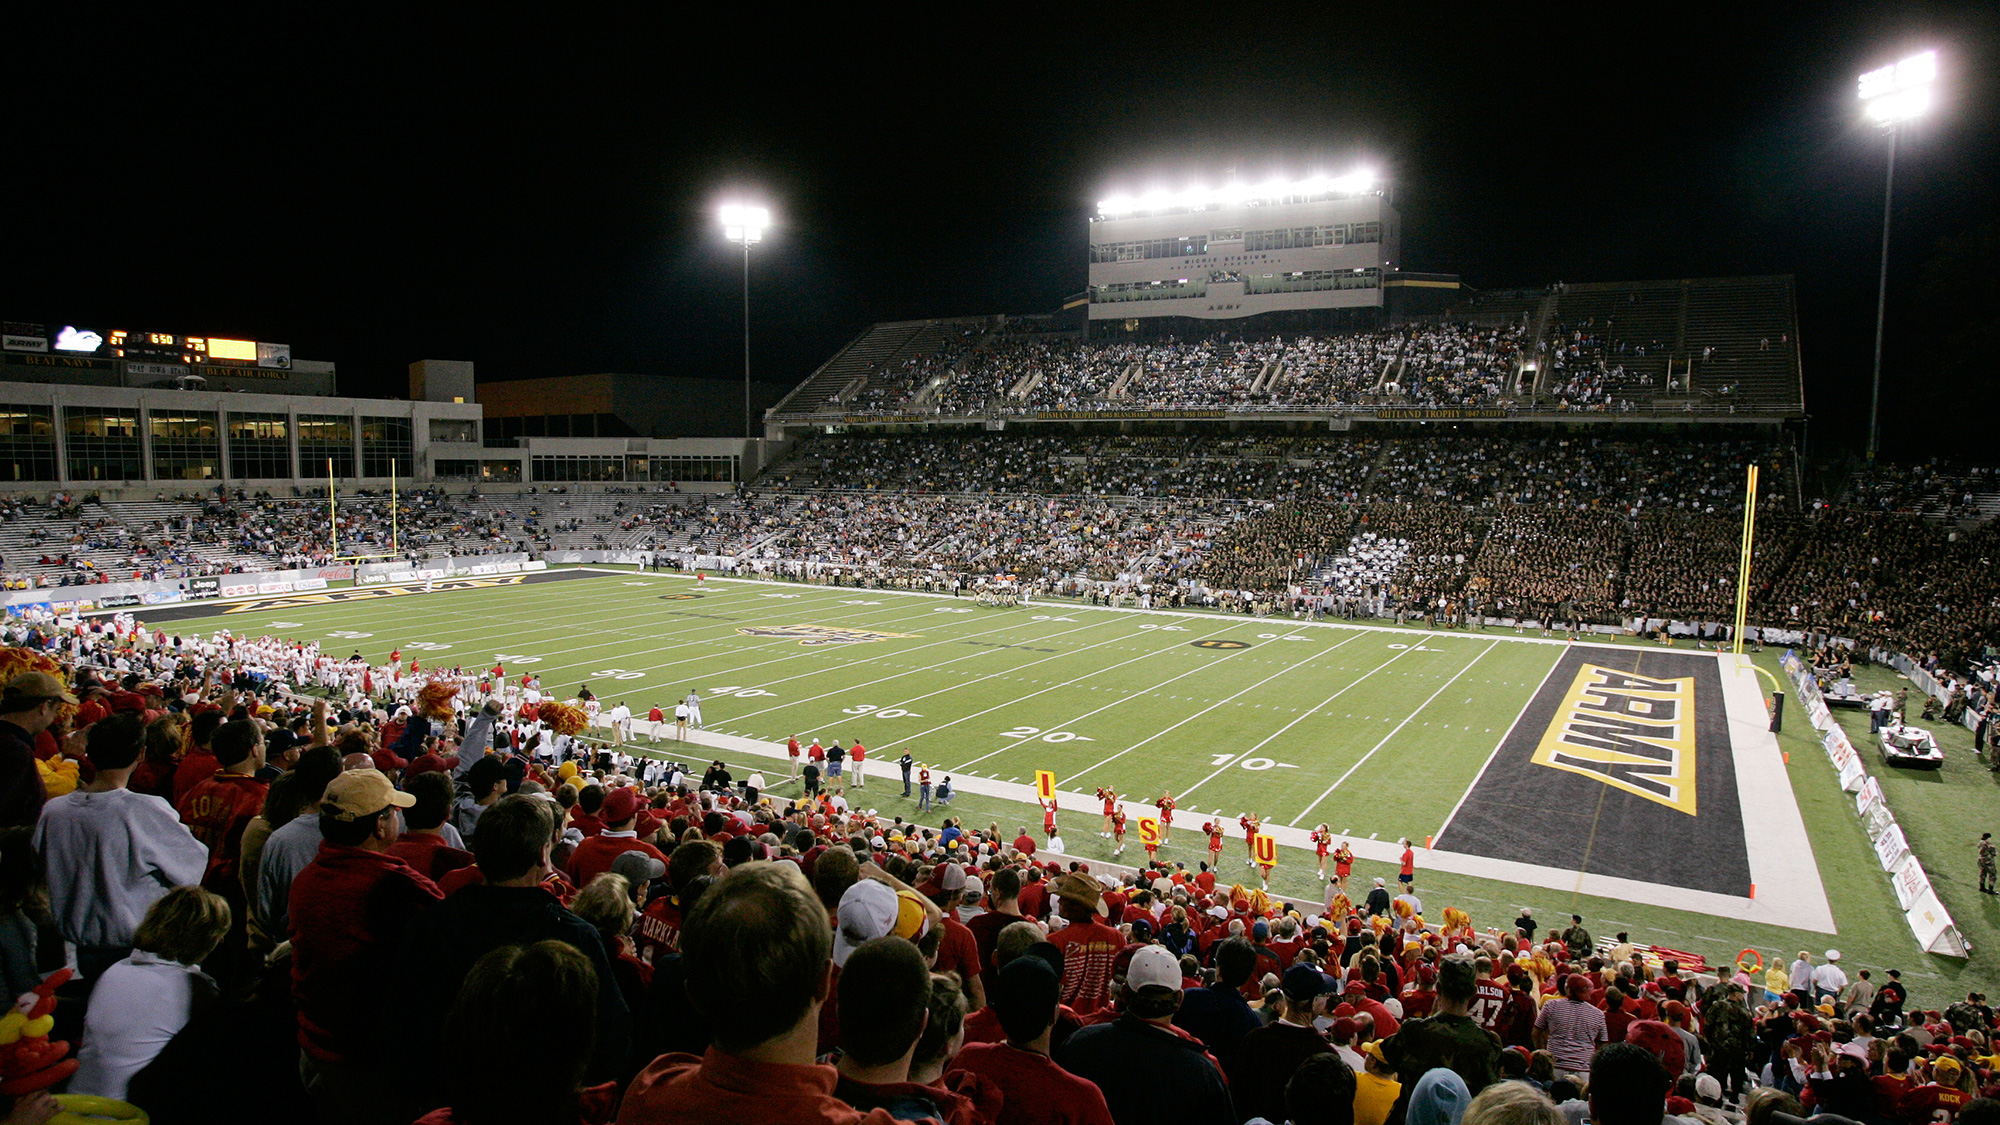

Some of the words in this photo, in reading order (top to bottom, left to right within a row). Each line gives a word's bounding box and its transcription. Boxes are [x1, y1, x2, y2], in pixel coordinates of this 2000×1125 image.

[7, 339, 43, 348] ARMY
[26, 355, 56, 366] BEAT
[63, 358, 94, 368] NAVY
[206, 367, 232, 376] BEAT
[236, 369, 254, 377] AIR
[258, 371, 288, 380] FORCE
[1071, 411, 1098, 419] TROPHY
[1378, 409, 1421, 419] OUTLAND
[1425, 409, 1460, 418] TROPHY
[193, 580, 217, 589] Jeep
[363, 574, 387, 583] Jeep
[591, 668, 646, 680] 50
[708, 686, 766, 697] 40
[842, 704, 908, 719] 30
[999, 726, 1077, 743] 20
[1546, 667, 1683, 804] ARMY
[1211, 753, 1276, 771] 10
[1041, 773, 1050, 797] I
[1140, 819, 1157, 842] S
[1256, 836, 1275, 862] U
[643, 915, 682, 952] HARKLA
[1467, 998, 1503, 1026] 47
[1938, 1092, 1961, 1104] KOCK
